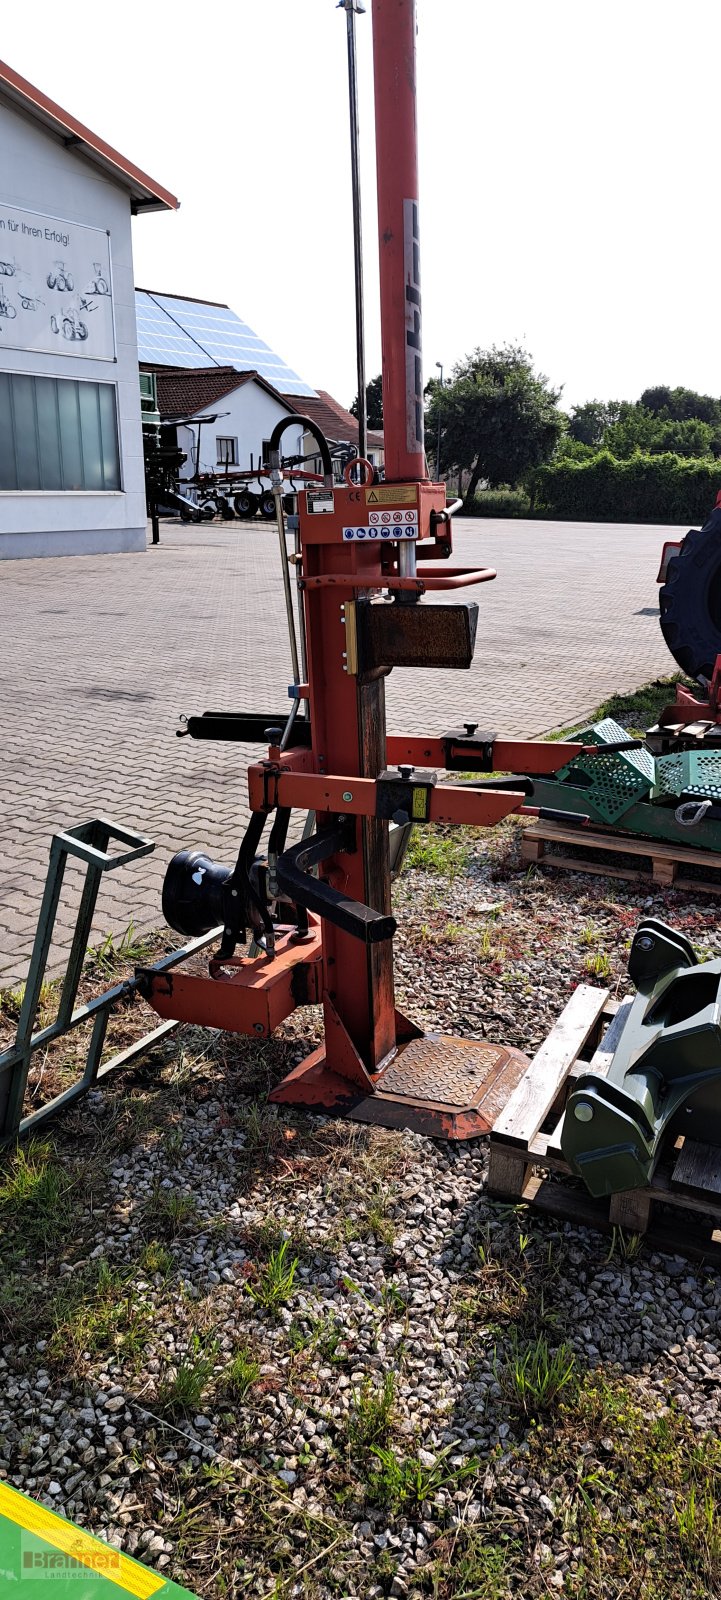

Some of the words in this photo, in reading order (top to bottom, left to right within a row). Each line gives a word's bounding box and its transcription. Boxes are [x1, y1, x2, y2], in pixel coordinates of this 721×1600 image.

[7, 219, 19, 231] für
[21, 222, 43, 238] Ihren
[44, 228, 70, 247] Erfolg!
